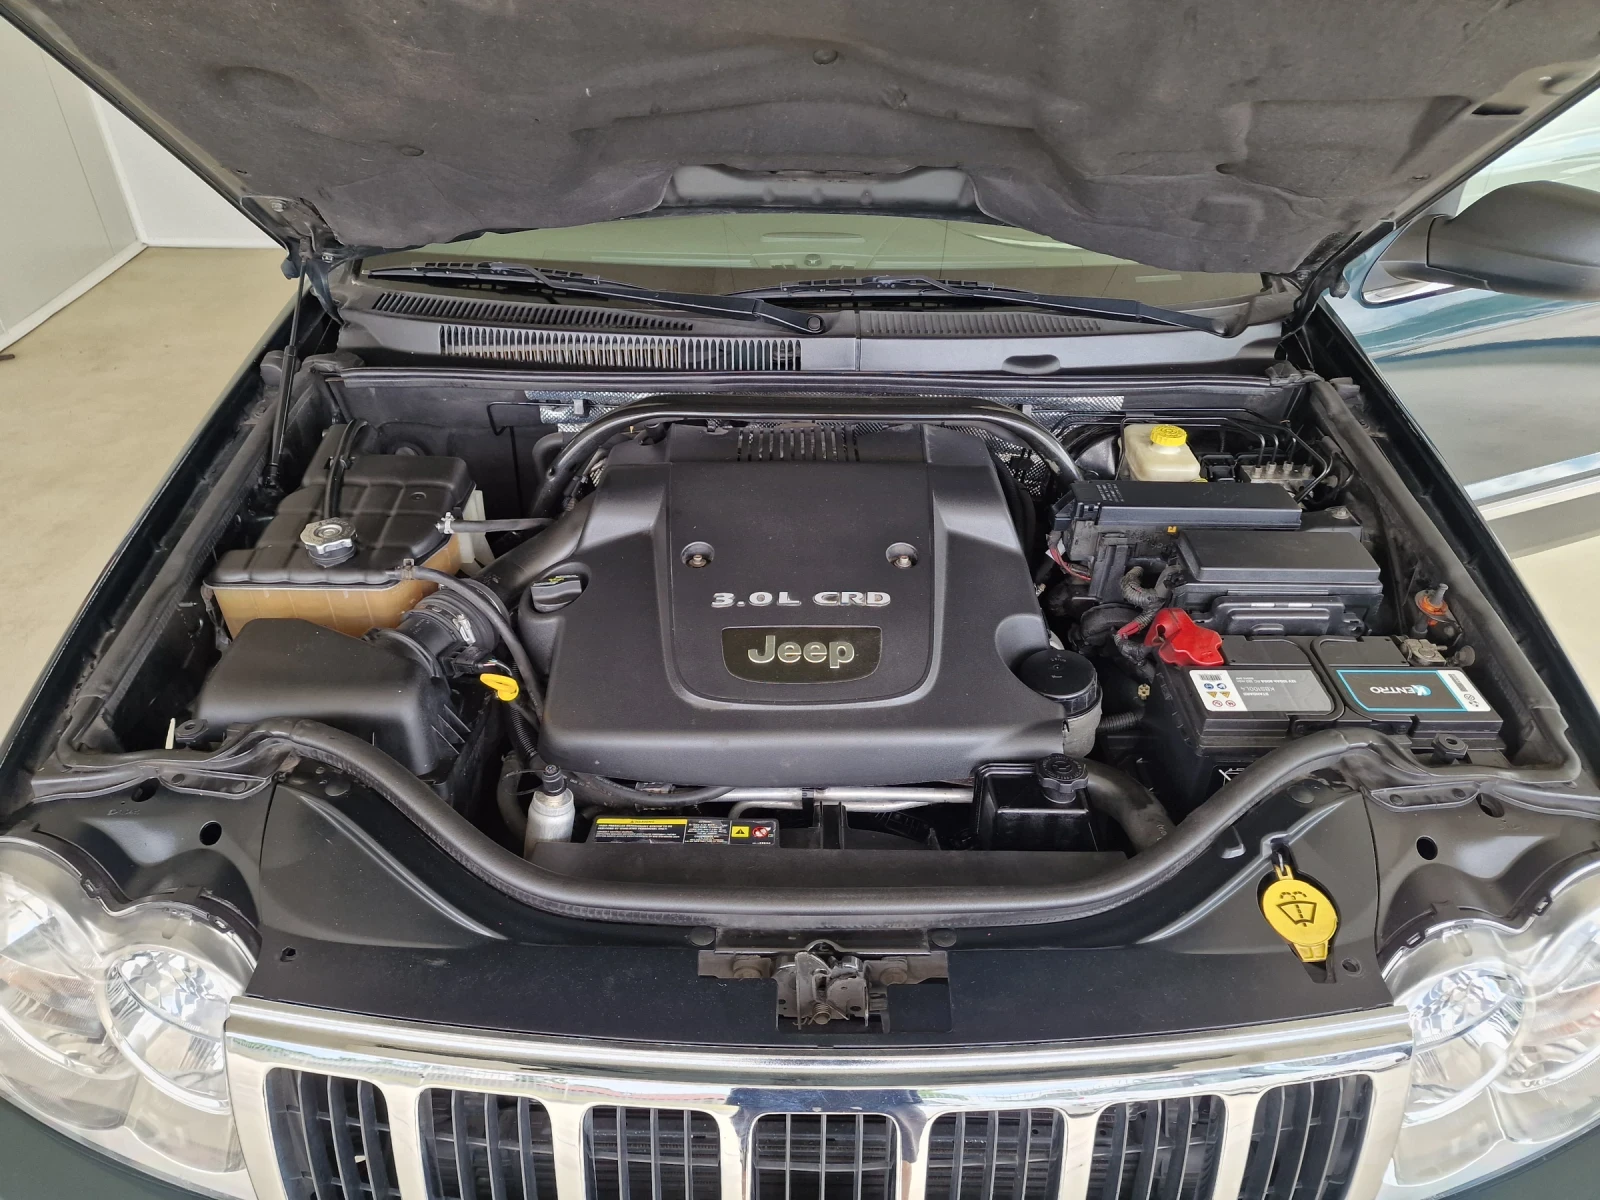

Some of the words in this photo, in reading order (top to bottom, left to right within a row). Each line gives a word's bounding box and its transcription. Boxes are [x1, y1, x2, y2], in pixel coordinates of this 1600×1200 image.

[711, 592, 802, 608] 3.0L
[813, 592, 891, 607] CRD
[747, 634, 855, 669] Jeep
[1370, 684, 1431, 697] KENTRO
